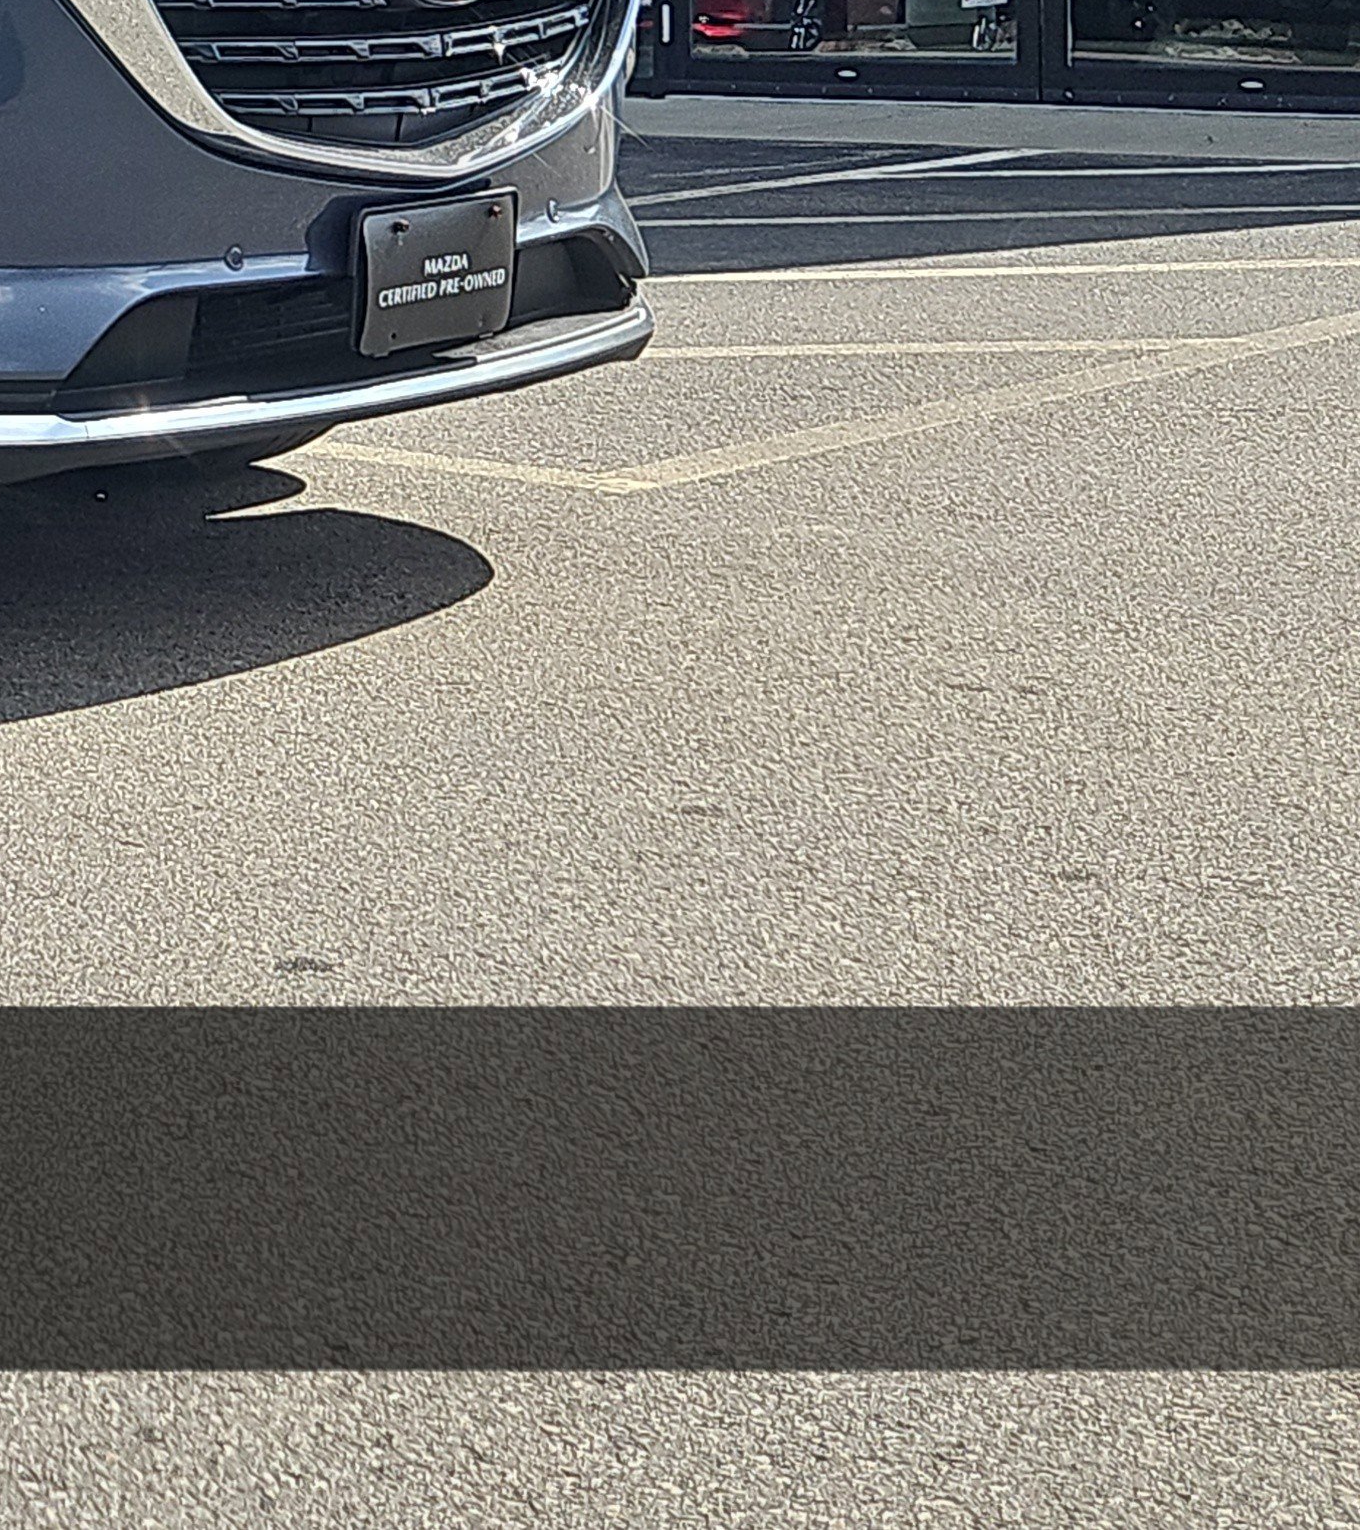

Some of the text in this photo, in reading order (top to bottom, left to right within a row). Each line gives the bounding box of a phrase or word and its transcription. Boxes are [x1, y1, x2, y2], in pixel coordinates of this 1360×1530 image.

[424, 254, 469, 276] MAZDA
[379, 268, 506, 308] CERTIFIED PRE-OWNED
